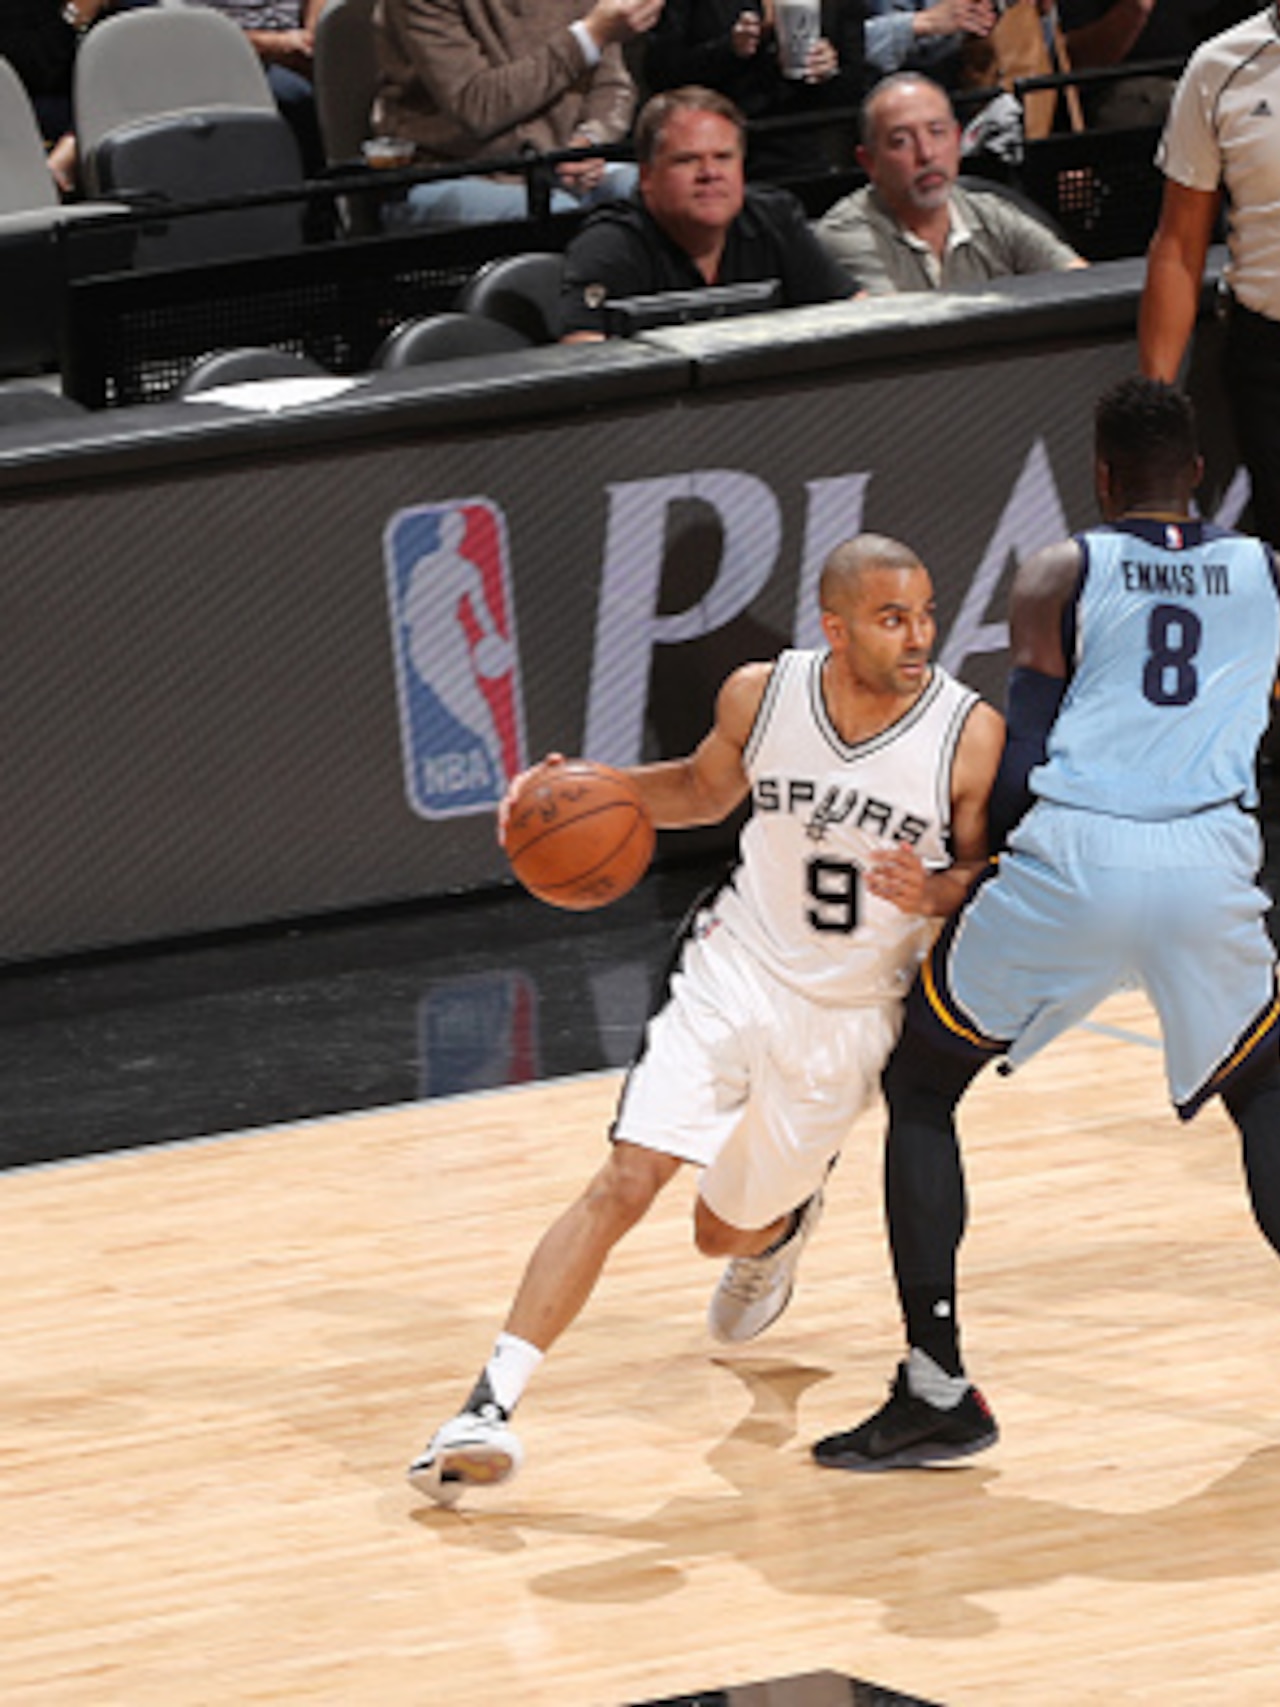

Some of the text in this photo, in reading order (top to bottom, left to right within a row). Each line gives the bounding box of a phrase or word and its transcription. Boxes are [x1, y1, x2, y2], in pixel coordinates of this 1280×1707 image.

[1120, 560, 1230, 597] ENNIS III
[1142, 603, 1202, 706] 8
[422, 748, 492, 794] NBA
[757, 778, 928, 846] SPURS
[806, 857, 863, 934] 9
